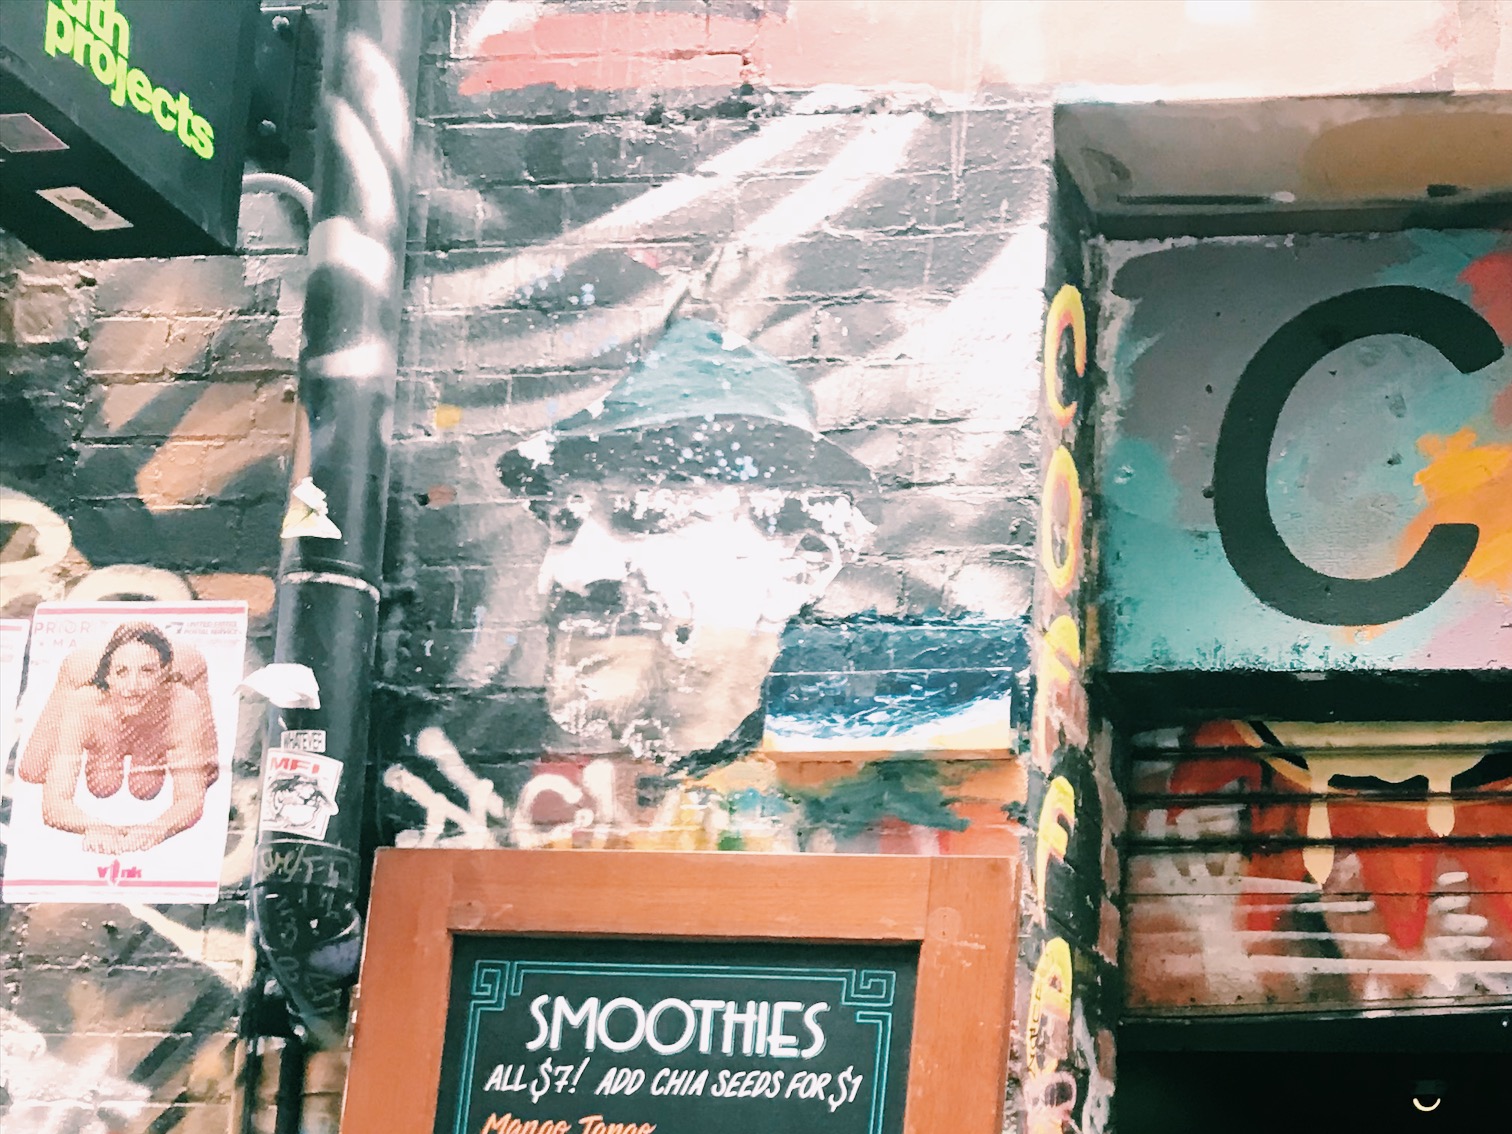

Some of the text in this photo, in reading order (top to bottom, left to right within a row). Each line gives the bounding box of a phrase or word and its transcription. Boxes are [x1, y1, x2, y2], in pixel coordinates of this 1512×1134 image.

[44, 2, 214, 160] projects
[525, 994, 832, 1061] SMOOTHIES
[482, 1056, 864, 1113] ALL $7! ADD CHIA SEEDS FOR $1
